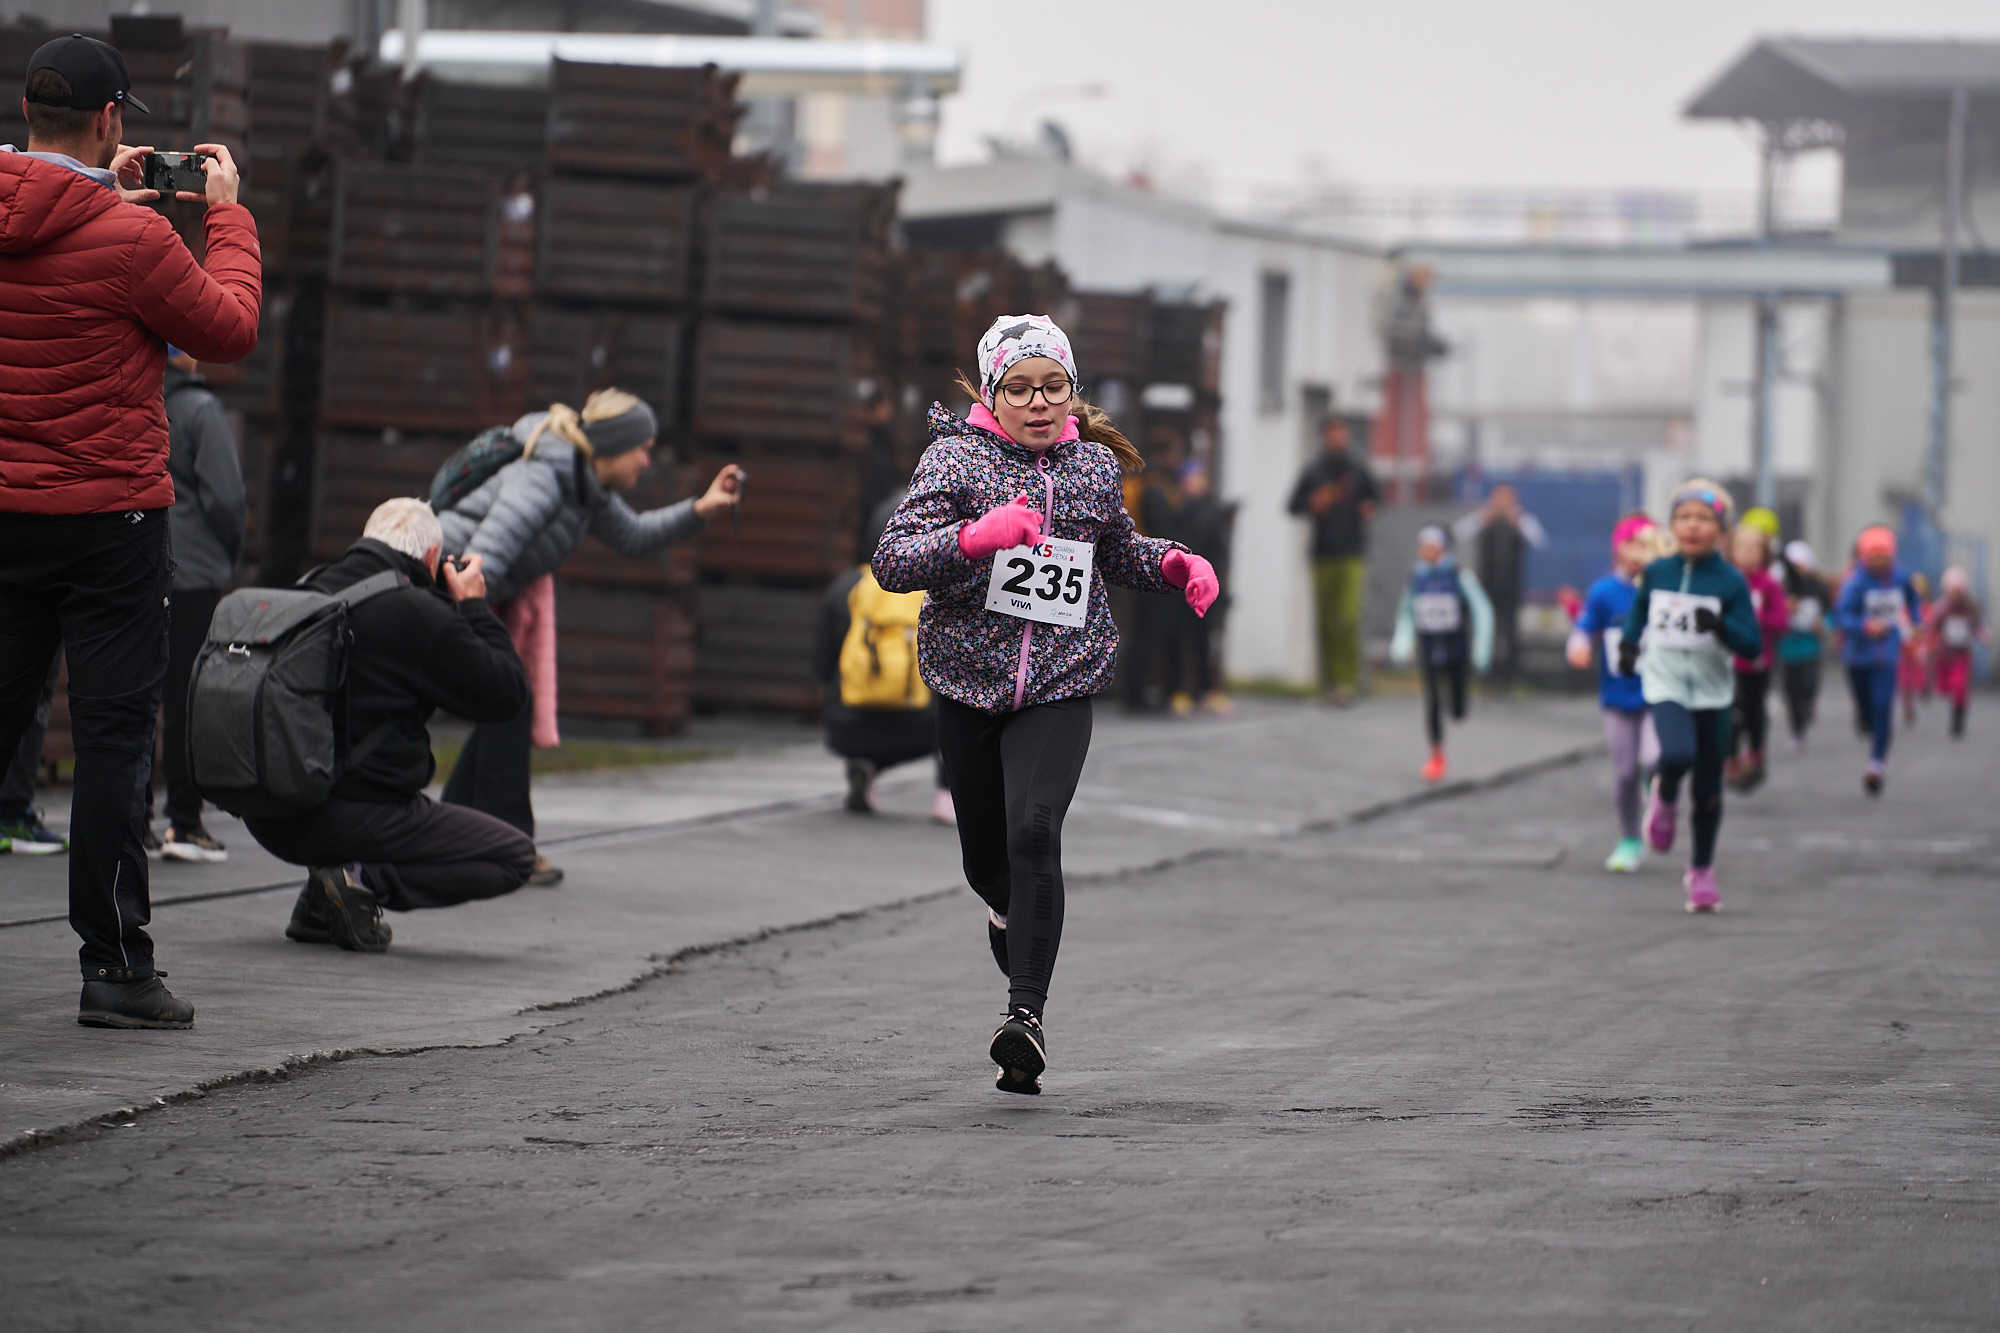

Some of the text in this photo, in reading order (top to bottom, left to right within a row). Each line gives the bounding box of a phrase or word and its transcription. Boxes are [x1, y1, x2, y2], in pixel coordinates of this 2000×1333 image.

[1032, 543, 1053, 557] K5
[1001, 557, 1084, 604] 235
[1658, 609, 1700, 632] 24
[1032, 803, 1051, 856] PUMA
[1034, 872, 1053, 921] PUMA
[1030, 937, 1049, 982] PUMA
